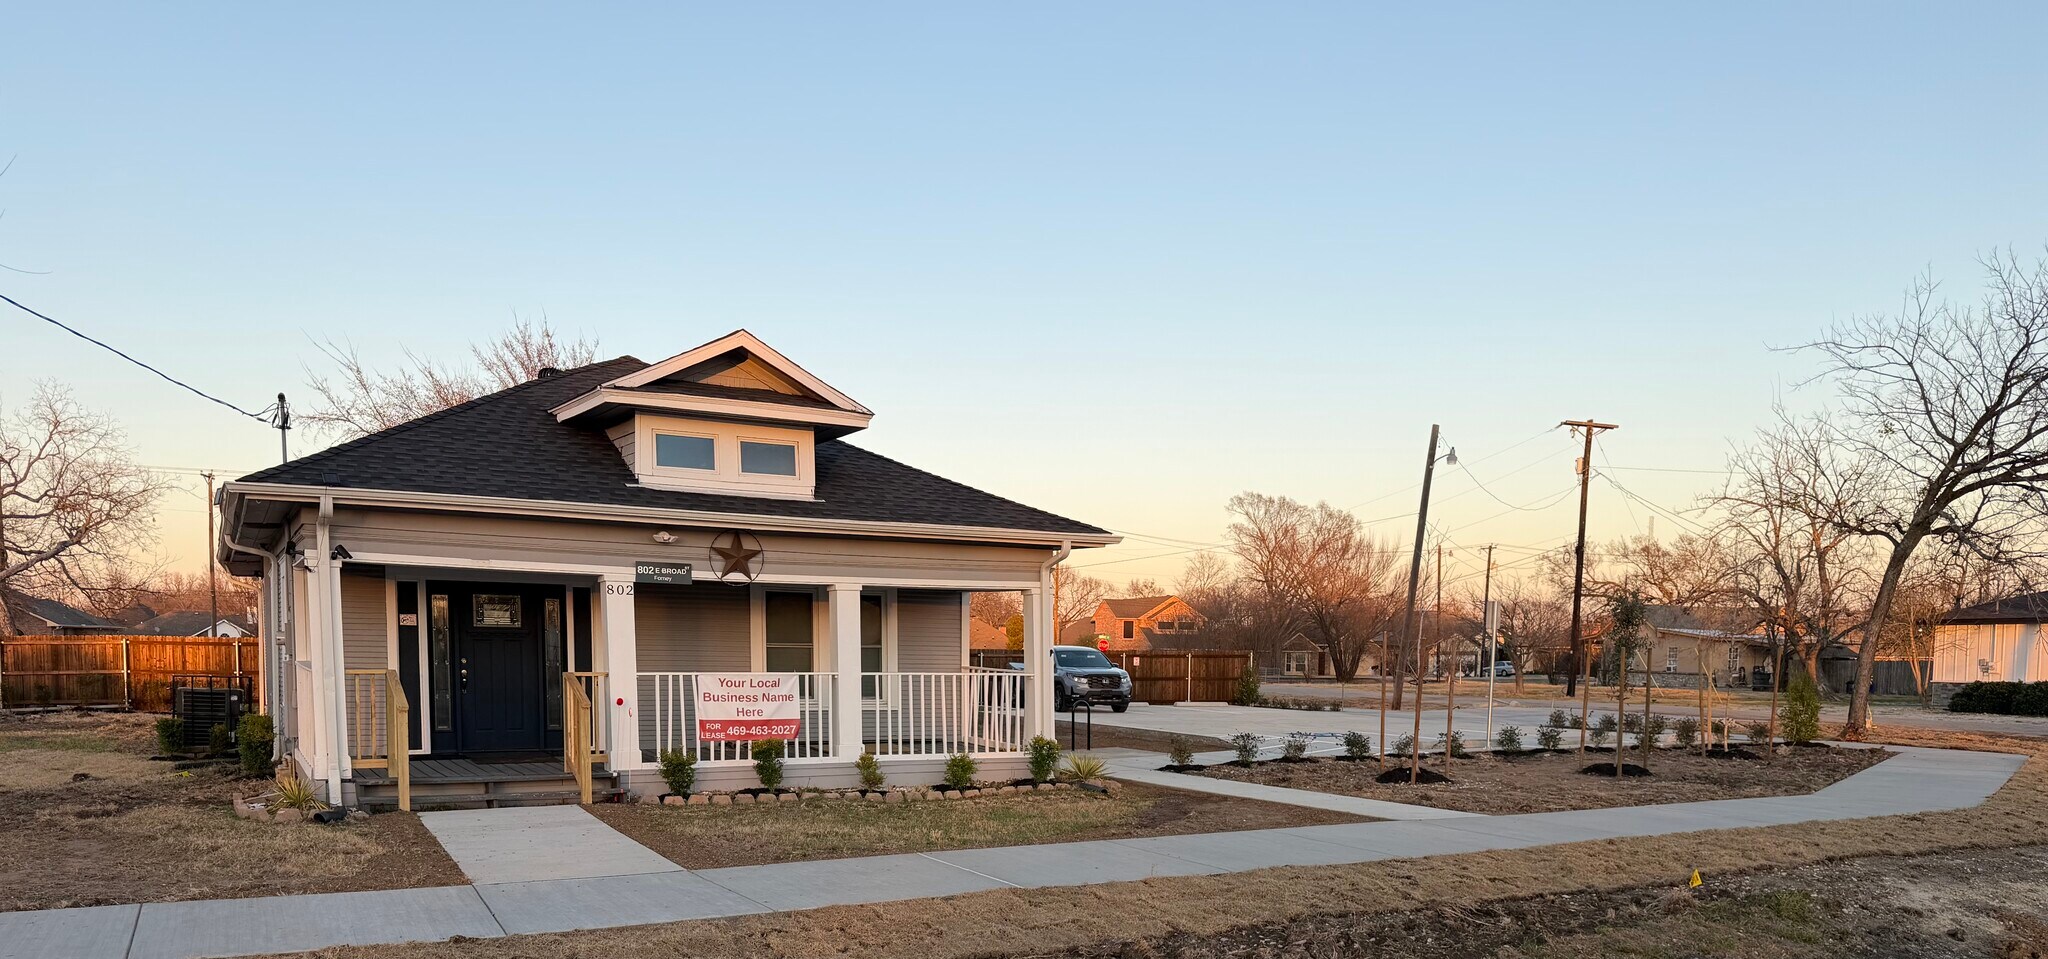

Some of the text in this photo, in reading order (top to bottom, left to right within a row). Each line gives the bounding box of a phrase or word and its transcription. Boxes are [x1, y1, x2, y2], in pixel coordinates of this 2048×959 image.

[637, 566, 654, 574] 802
[661, 567, 687, 575] BROAD
[606, 584, 634, 595] 802
[718, 677, 781, 688] Your Local
[703, 692, 794, 702] Business Name
[736, 707, 763, 717] Here
[726, 725, 796, 735] 469-463-2027
